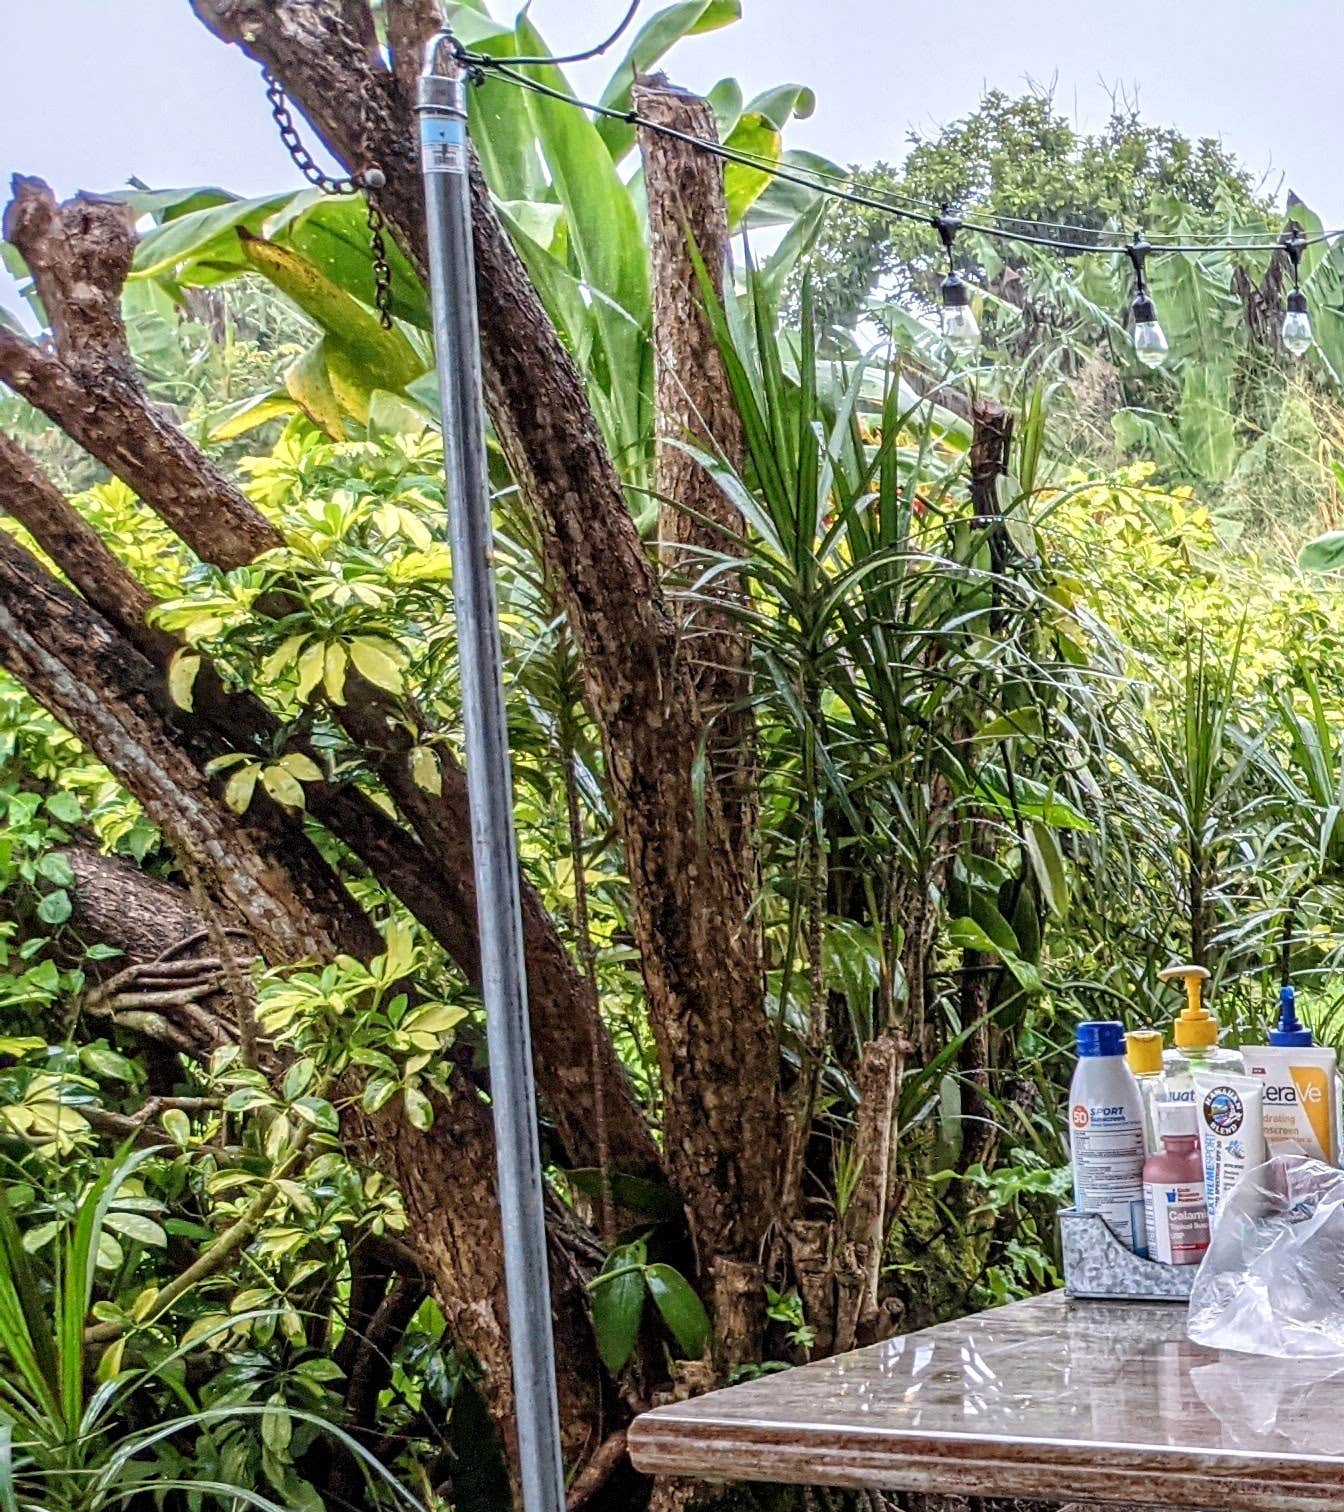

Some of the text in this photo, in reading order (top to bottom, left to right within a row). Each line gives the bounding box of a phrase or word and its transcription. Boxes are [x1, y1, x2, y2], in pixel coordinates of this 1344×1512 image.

[1262, 1081, 1322, 1103] eraVe
[1074, 1111, 1088, 1124] 50
[1090, 1106, 1124, 1116] SPORT
[1210, 1121, 1238, 1135] BLEND
